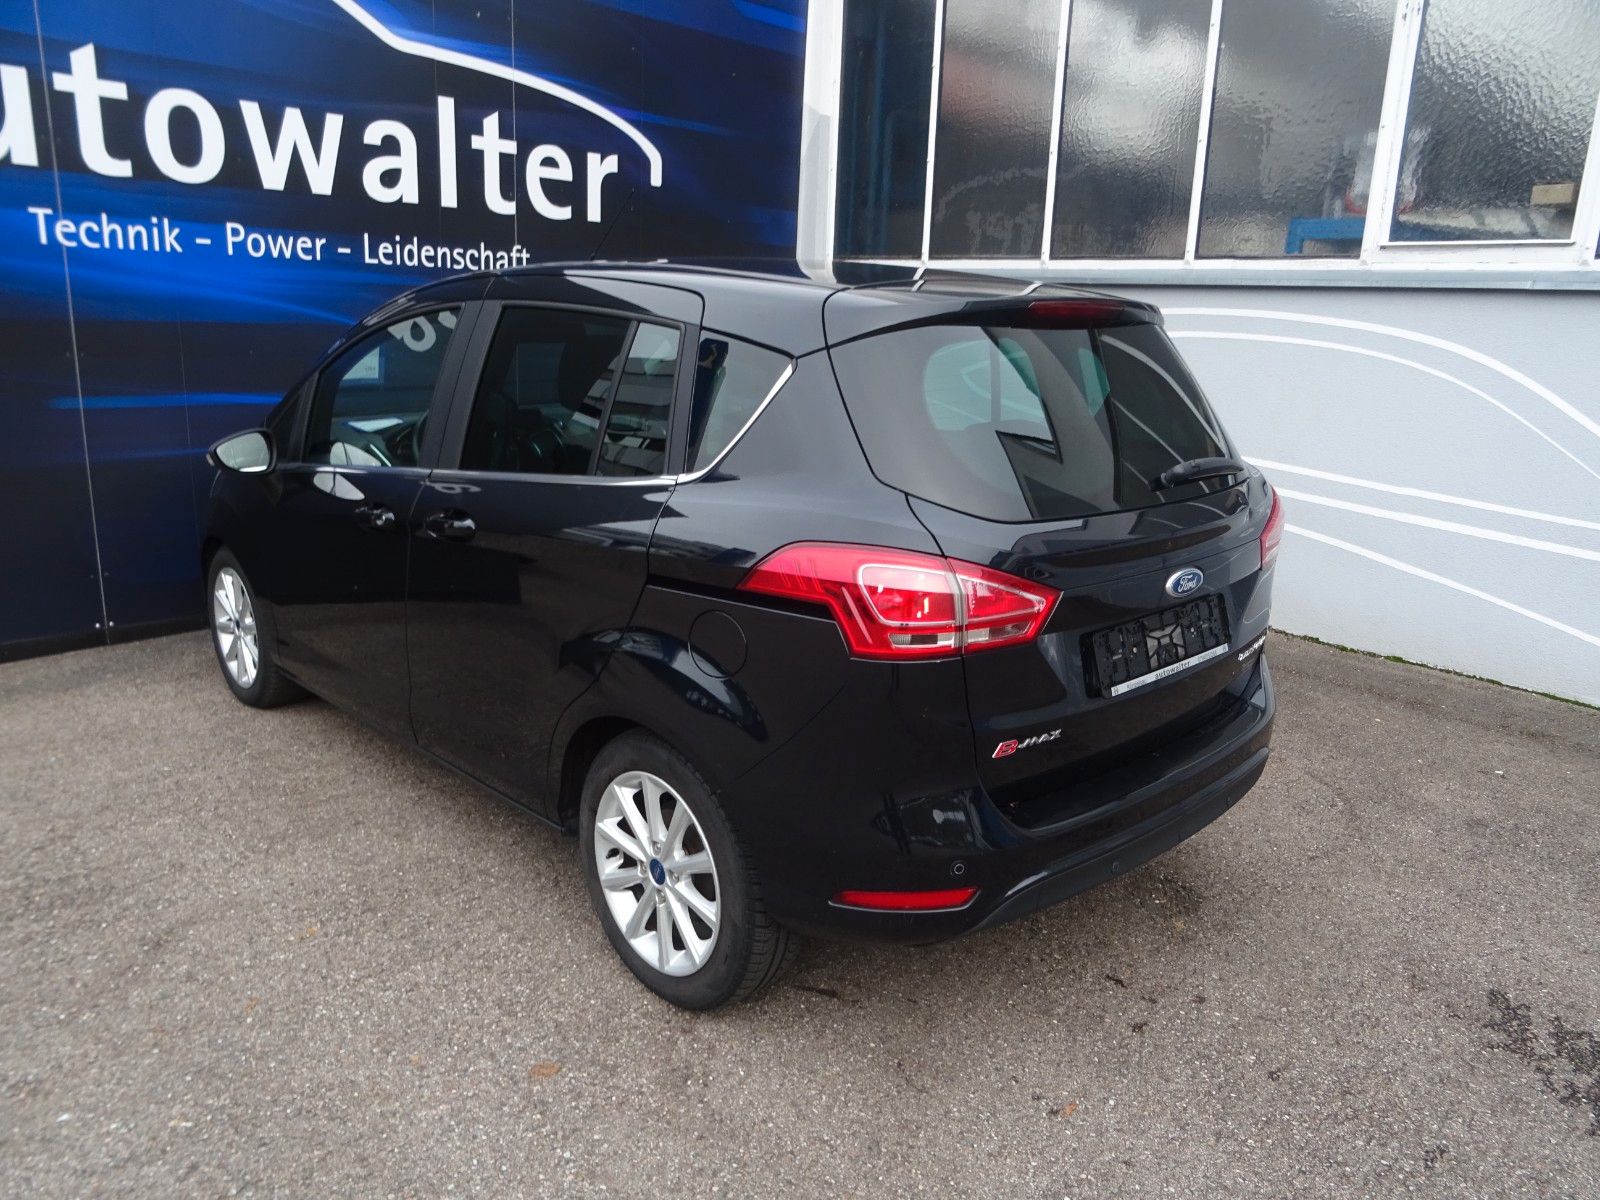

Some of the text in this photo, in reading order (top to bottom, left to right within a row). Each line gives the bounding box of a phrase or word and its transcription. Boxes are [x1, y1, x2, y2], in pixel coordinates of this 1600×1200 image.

[27, 206, 182, 253] Technik
[226, 221, 326, 261] Power
[363, 232, 530, 271] Leidenschaft
